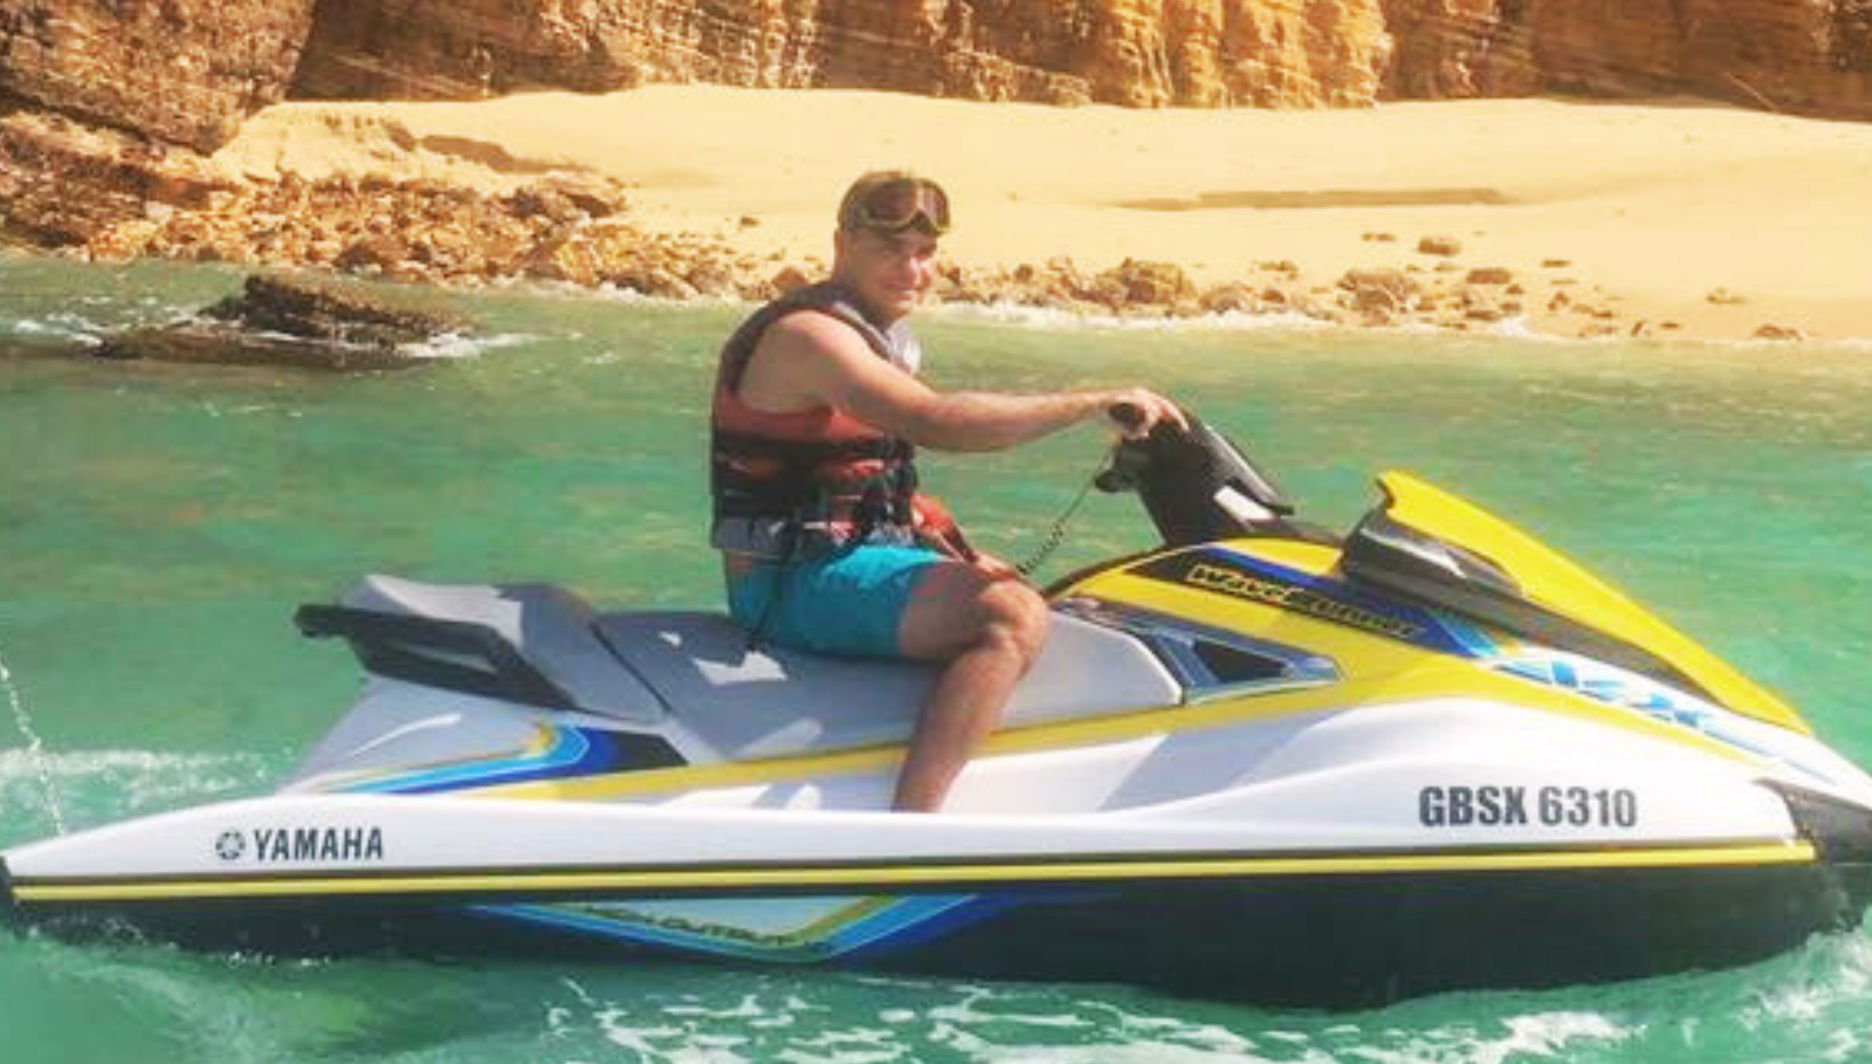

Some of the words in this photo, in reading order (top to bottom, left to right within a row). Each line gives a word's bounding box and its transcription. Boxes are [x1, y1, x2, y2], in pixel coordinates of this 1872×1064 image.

[1418, 785, 1528, 827] GBSX
[1538, 785, 1638, 828] 6310
[253, 826, 384, 862] YAMAHA
